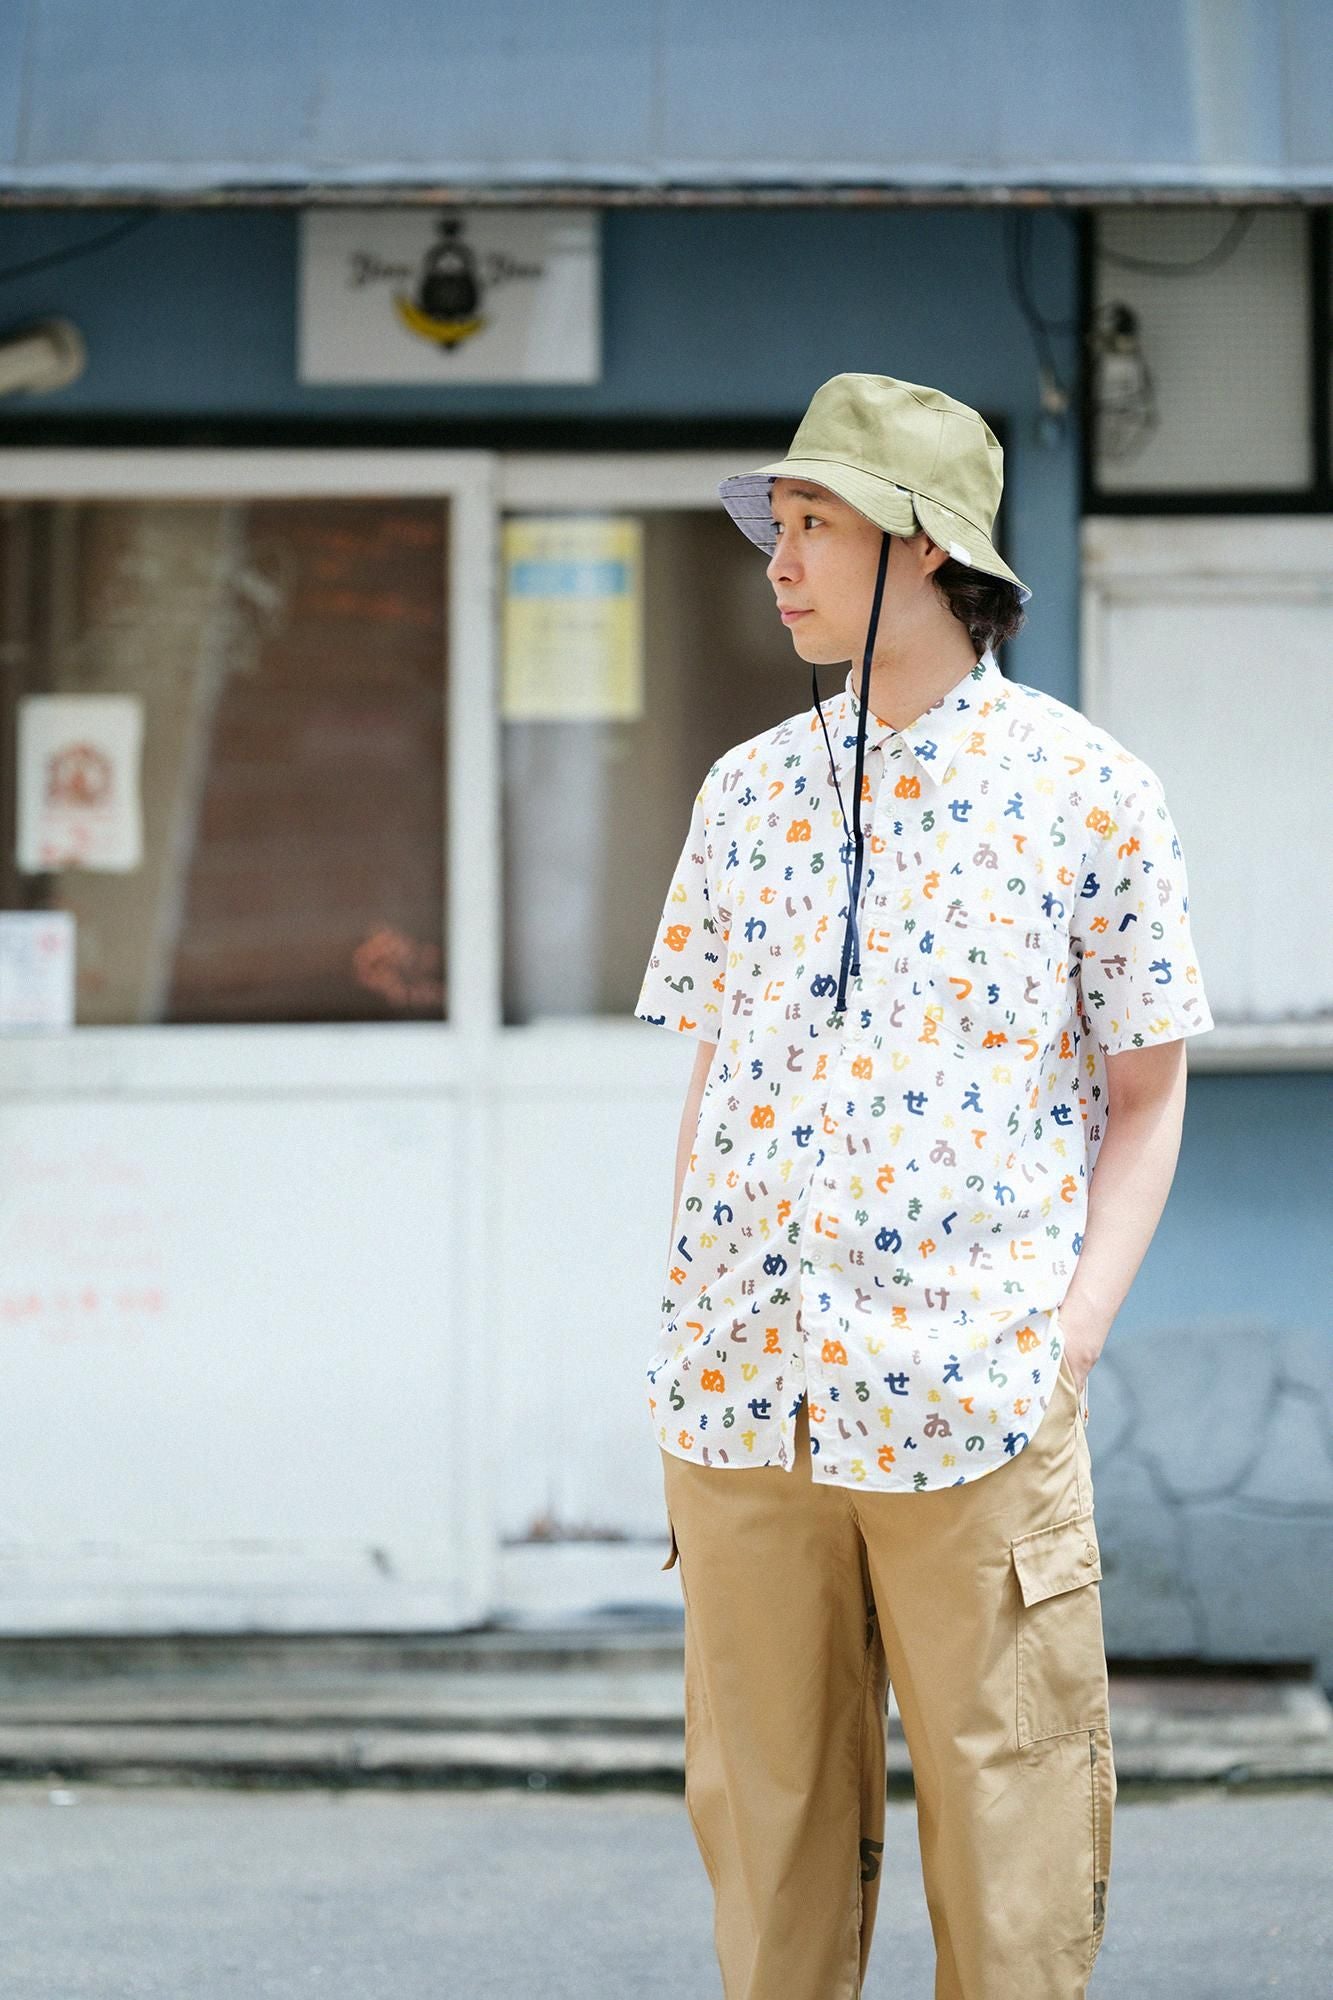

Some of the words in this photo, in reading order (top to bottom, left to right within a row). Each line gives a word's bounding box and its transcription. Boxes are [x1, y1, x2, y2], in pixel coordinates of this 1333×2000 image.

[1008, 719, 1035, 742] け
[1028, 747, 1047, 762] ふ
[1064, 755, 1085, 775] つ
[723, 769, 743, 793] け
[794, 776, 806, 796] ち
[894, 775, 921, 800] ぬ
[738, 787, 757, 806] ふ
[810, 797, 820, 810] り
[1004, 792, 1024, 819] え
[921, 810, 935, 832] る
[948, 800, 972, 822] せ
[786, 819, 811, 843] ぬ
[1051, 816, 1065, 846] ら
[726, 840, 739, 870] え
[749, 840, 766, 871] ら
[871, 835, 886, 854] む
[1013, 835, 1026, 854] て
[810, 852, 824, 874] る
[897, 851, 921, 872] い
[973, 844, 998, 869] ゐ
[950, 862, 963, 875] ん
[1057, 867, 1074, 886] む
[760, 887, 776, 904] む
[923, 871, 940, 899] さ
[1007, 878, 1025, 895] の
[786, 896, 812, 918] い
[945, 904, 968, 928] た
[1041, 892, 1064, 919] わ
[744, 917, 766, 943] わ
[867, 928, 890, 952] に
[968, 947, 987, 965] れ
[752, 964, 761, 977] よ
[664, 976, 694, 993] ら
[764, 982, 784, 1001] に
[810, 974, 837, 998] め
[949, 977, 972, 1000] つ
[987, 984, 1000, 1005] ち
[1024, 976, 1040, 1004] と
[732, 990, 754, 1016] た
[890, 1000, 905, 1027] と
[861, 1009, 872, 1029] ち
[1006, 1010, 1015, 1025] り
[810, 1024, 819, 1038] し
[787, 1045, 804, 1072] と
[954, 1044, 964, 1059] こ
[1016, 1039, 1039, 1061] つ
[751, 1059, 763, 1080] ち
[851, 1056, 872, 1080] ぬ
[770, 1082, 780, 1096] り
[961, 1082, 983, 1113] え
[871, 1096, 885, 1117] る
[903, 1090, 928, 1116] せ
[750, 1105, 775, 1130] ぬ
[823, 1115, 838, 1134] む
[1008, 1104, 1020, 1135] ら
[1050, 1104, 1073, 1126] せ
[715, 1123, 733, 1155] ら
[792, 1125, 814, 1148] せ
[846, 1134, 871, 1155] い
[972, 1130, 986, 1149] て
[767, 1138, 778, 1159] る
[930, 1140, 956, 1166] ゐ
[906, 1159, 919, 1172] ん
[1021, 1163, 1048, 1183] い
[727, 1171, 739, 1188] む
[876, 1165, 894, 1194] さ
[966, 1175, 984, 1192] の
[1061, 1175, 1077, 1203] さ
[745, 1181, 768, 1202] い
[994, 1181, 1015, 1206] わ
[686, 1197, 702, 1212] の
[713, 1200, 733, 1226] わ
[777, 1200, 791, 1226] さ
[908, 1198, 922, 1221] き
[815, 1212, 839, 1239] に
[855, 1210, 868, 1226] ゆ
[942, 1211, 958, 1235] く
[788, 1221, 800, 1245] き
[875, 1226, 902, 1254] め
[1046, 1225, 1060, 1239] ゆ
[677, 1235, 693, 1262] く
[918, 1239, 936, 1258] や
[969, 1243, 992, 1269] た
[1010, 1240, 1035, 1260] に
[762, 1254, 788, 1277] め
[874, 1276, 885, 1288] し
[892, 1269, 913, 1286] み
[1004, 1281, 1024, 1294] れ
[751, 1301, 760, 1314] し
[770, 1288, 791, 1305] み
[818, 1292, 831, 1312] ち
[855, 1288, 871, 1314] と
[925, 1288, 950, 1311] け
[839, 1318, 849, 1332] り
[953, 1310, 974, 1327] ふ
[990, 1310, 1013, 1322] つ
[686, 1322, 704, 1342] つ
[730, 1319, 747, 1343] と
[763, 1328, 783, 1354] ゑ
[716, 1350, 727, 1362] り
[821, 1339, 848, 1366] ぬ
[741, 1363, 758, 1381] ひ
[942, 1354, 963, 1384] え
[989, 1360, 1007, 1387] ら
[700, 1369, 725, 1393] ぬ
[855, 1381, 870, 1402] る
[883, 1372, 910, 1396] せ
[669, 1379, 685, 1411] ら
[829, 1387, 840, 1402] を
[959, 1397, 974, 1414] て
[722, 1407, 735, 1428] る
[748, 1398, 772, 1420] せ
[878, 1406, 894, 1428] す
[699, 1414, 708, 1430] を
[838, 1418, 868, 1439] い
[923, 1413, 952, 1438] ゐ
[678, 1430, 694, 1449] む
[740, 1430, 756, 1452] す
[903, 1436, 917, 1449] ん
[965, 1436, 984, 1452] の
[1003, 1432, 1029, 1456] わ
[877, 1445, 896, 1473] さ
[851, 1460, 867, 1482] ろ
[913, 1471, 928, 1492] き
